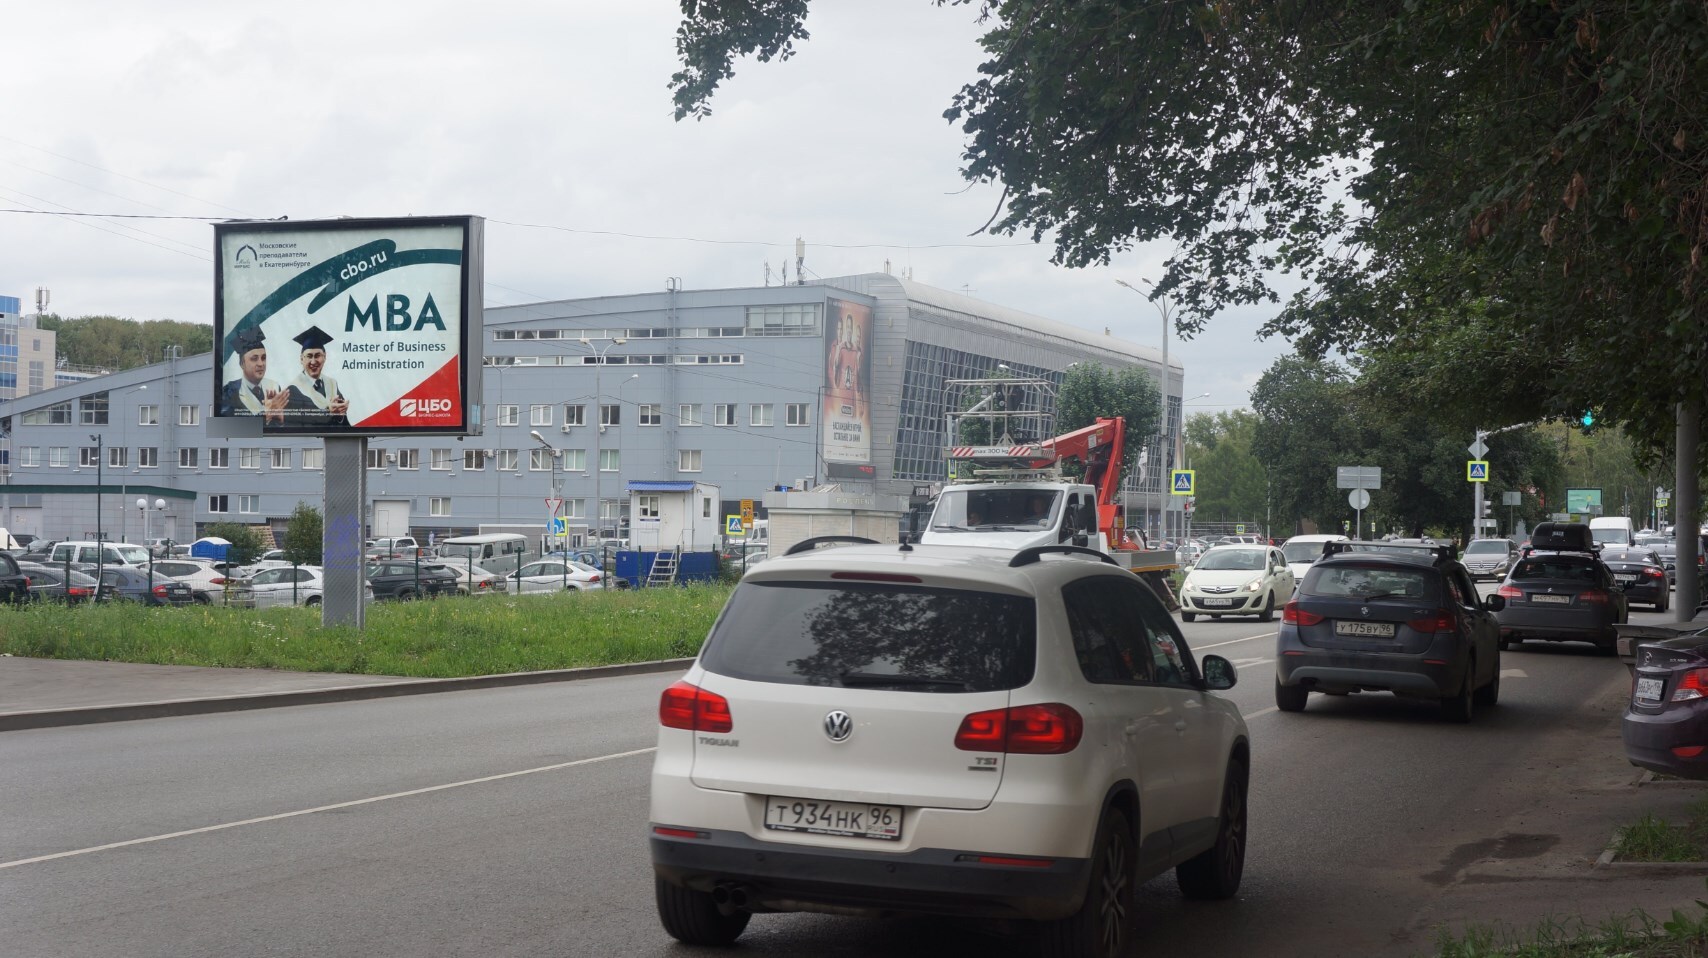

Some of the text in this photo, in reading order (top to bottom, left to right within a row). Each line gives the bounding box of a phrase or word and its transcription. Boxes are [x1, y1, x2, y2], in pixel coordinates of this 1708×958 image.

[264, 260, 311, 269] Екатеринбурге
[340, 250, 387, 280] cbo.ru
[345, 291, 447, 332] MBA
[342, 341, 446, 353] Master of Business
[341, 358, 425, 370] Administration
[418, 398, 452, 414] ЦБО
[1340, 623, 1391, 634] У175ВУ 96
[698, 736, 740, 747] TIGUAN
[777, 802, 892, 830] Т934НК 96
